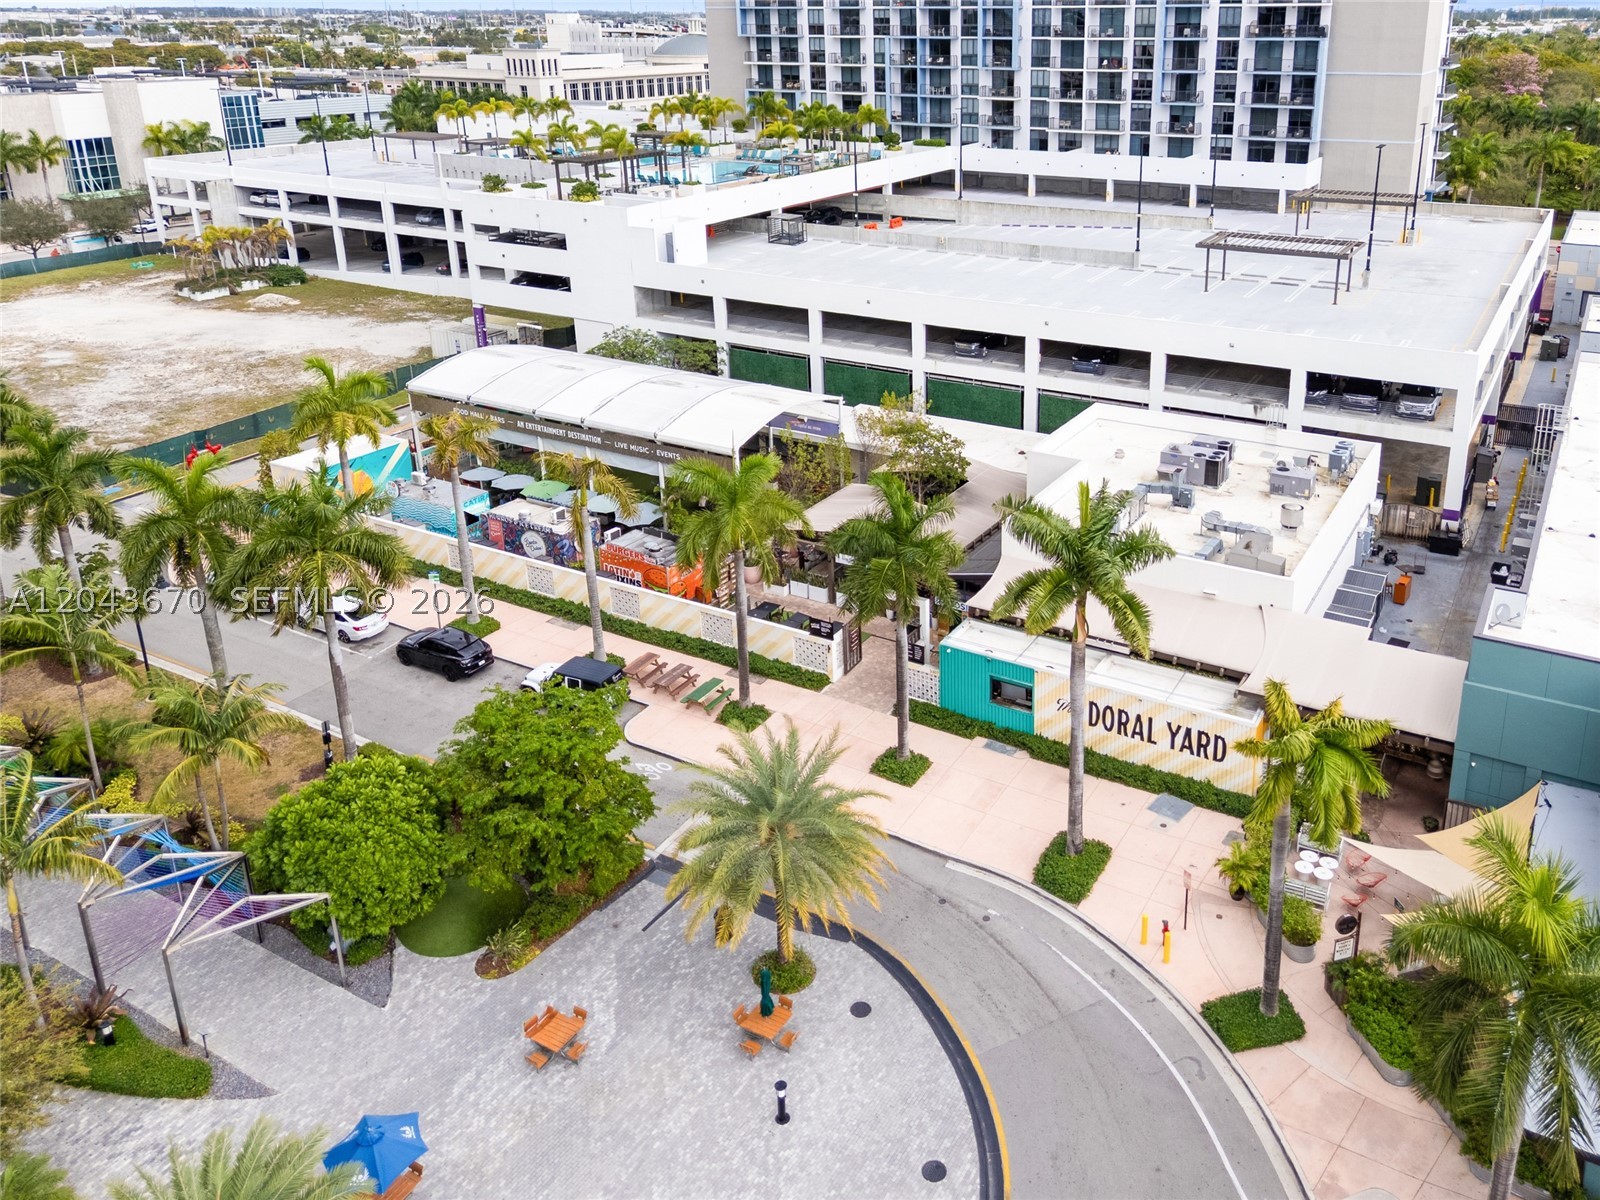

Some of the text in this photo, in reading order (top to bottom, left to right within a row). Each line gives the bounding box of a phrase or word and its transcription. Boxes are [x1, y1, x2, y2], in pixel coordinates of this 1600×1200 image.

[516, 420, 525, 429] AN
[525, 423, 566, 438] ENTERTAINMENT
[567, 430, 602, 445] DESTINATION
[614, 441, 628, 450] LIVE
[629, 444, 650, 454] MUSIC
[656, 449, 681, 460] EVENTS
[606, 543, 646, 561] BURGERS
[616, 574, 642, 588] IXINS
[1088, 700, 1158, 746] DORAL
[1166, 720, 1228, 763] YARD
